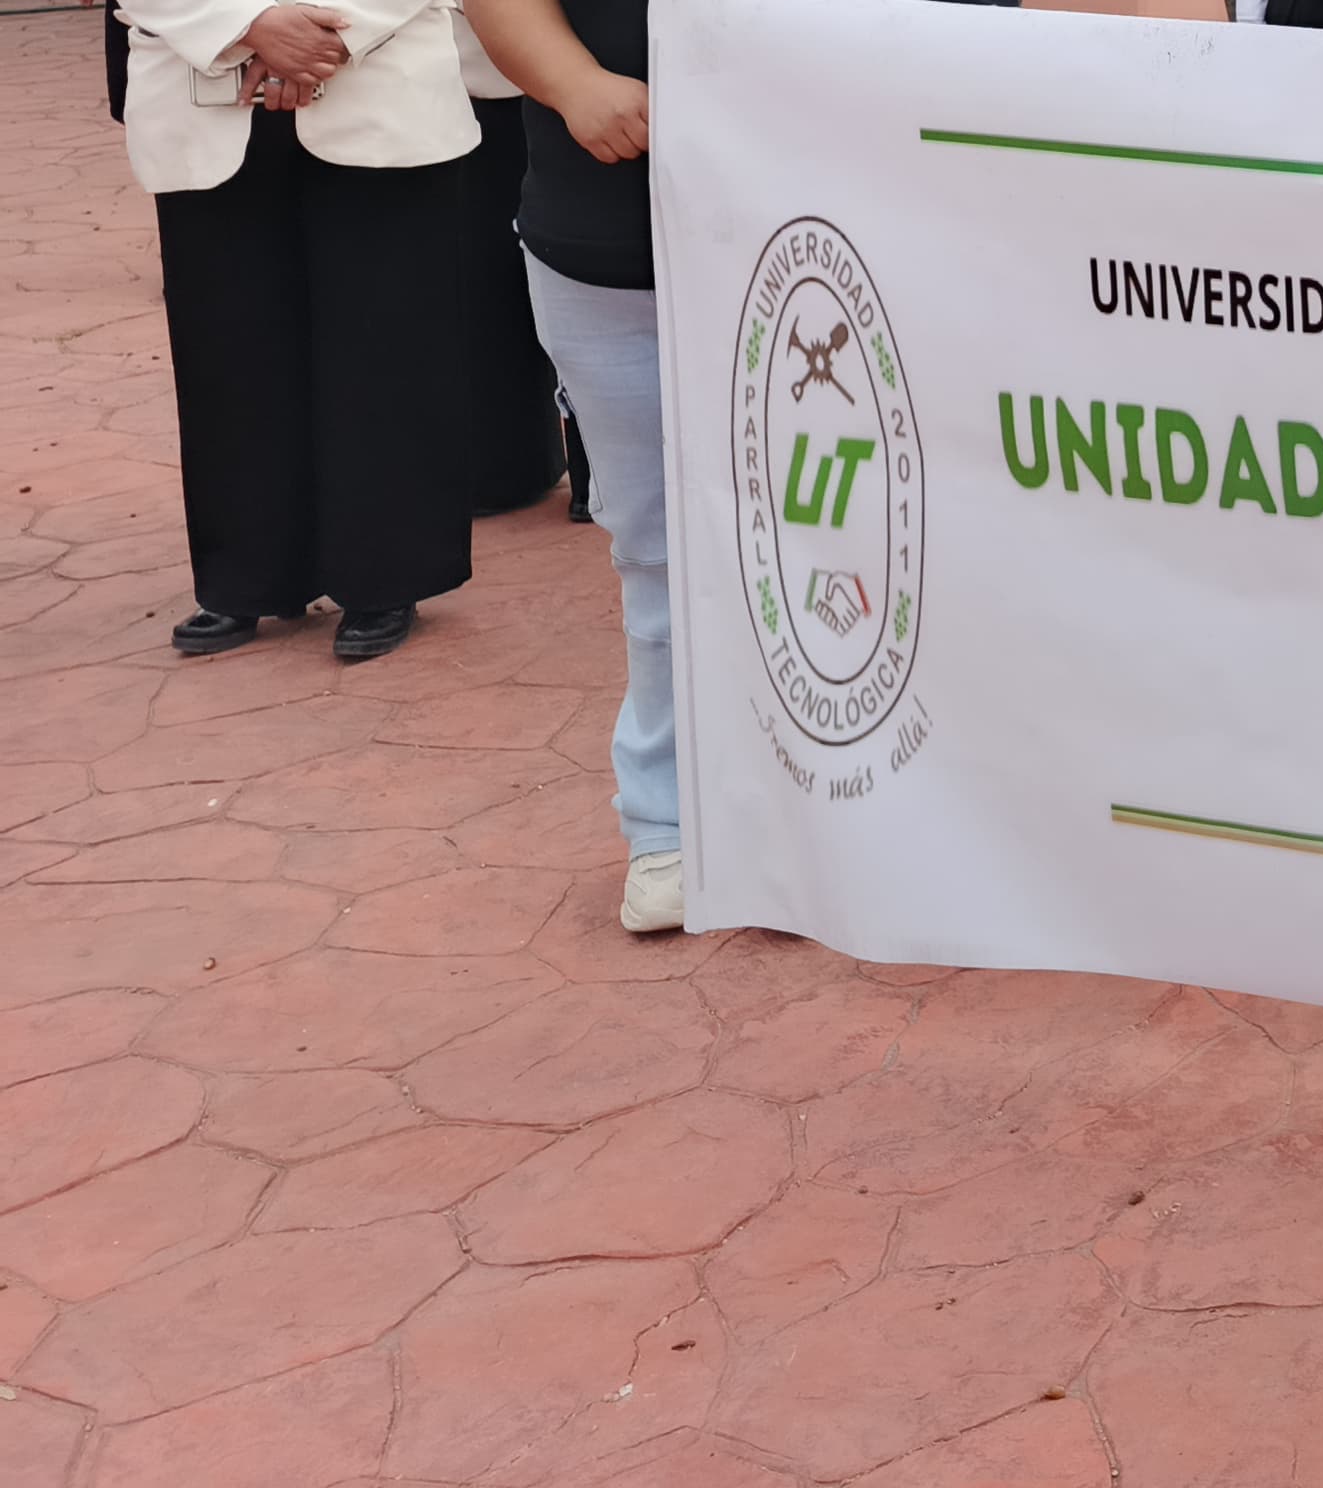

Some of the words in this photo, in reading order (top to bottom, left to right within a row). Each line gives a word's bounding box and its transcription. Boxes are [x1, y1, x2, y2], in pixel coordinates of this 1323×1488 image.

[756, 231, 875, 328] UNIVERSIDAD
[744, 385, 768, 567] PARRAL
[783, 432, 877, 529] UT
[891, 408, 910, 573] 2011
[770, 636, 905, 731] TECNOLÓGICA
[829, 765, 874, 801] más
[891, 695, 934, 773] allá!
